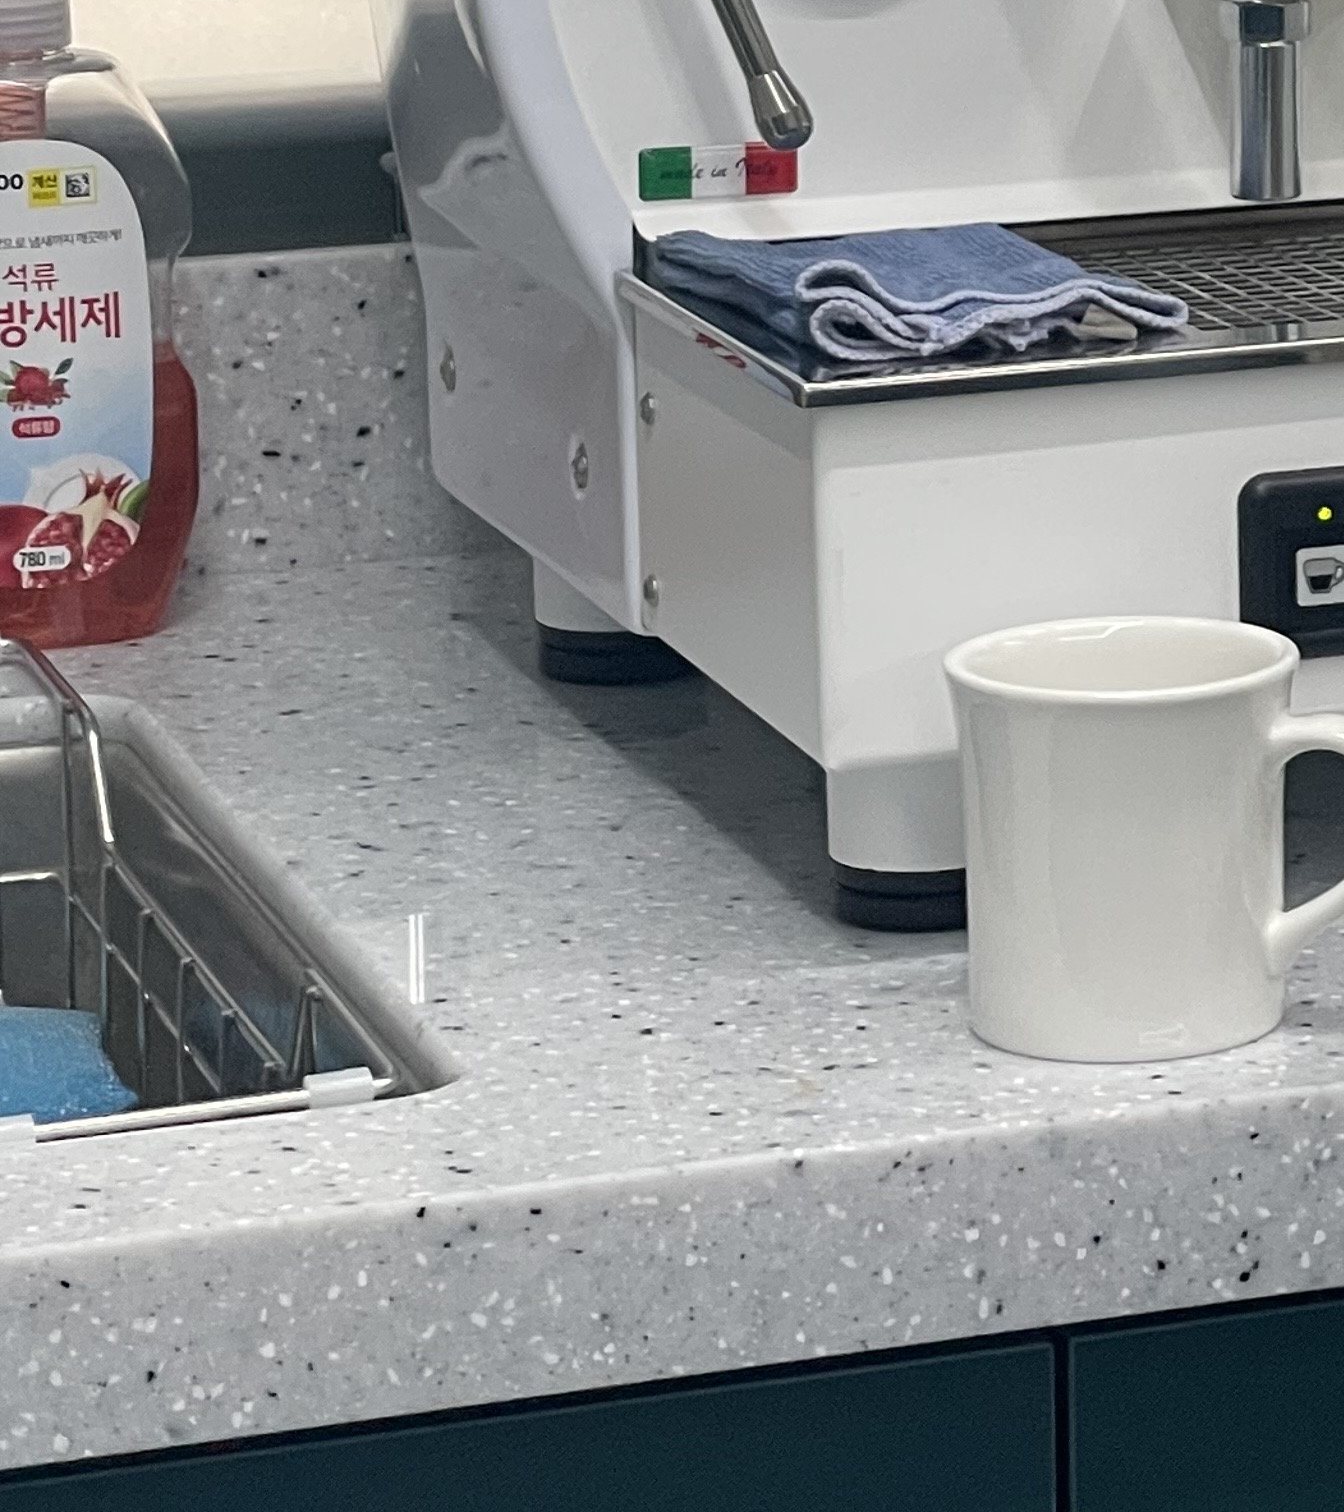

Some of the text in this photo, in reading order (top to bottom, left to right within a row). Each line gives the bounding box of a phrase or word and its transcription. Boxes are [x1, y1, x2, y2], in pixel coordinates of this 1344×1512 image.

[2, 262, 60, 293] 석류
[0, 290, 121, 349] 방세제
[19, 551, 46, 568] 780
